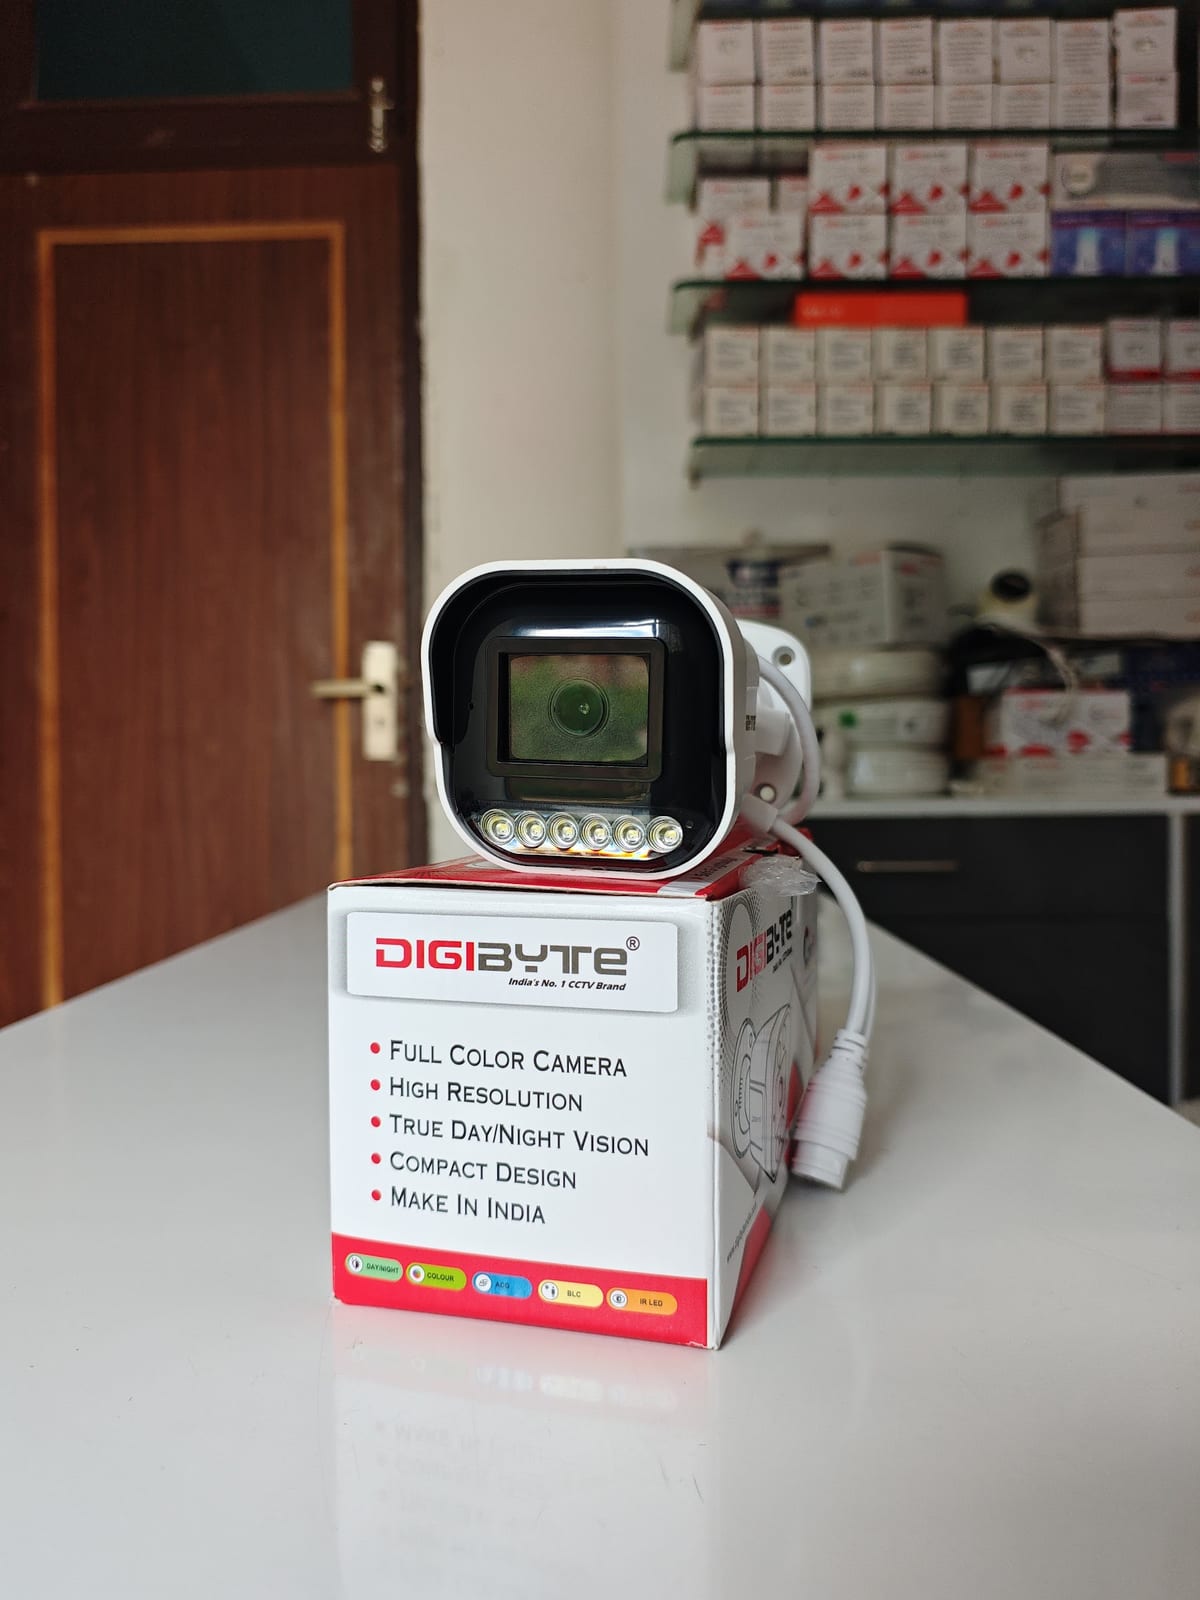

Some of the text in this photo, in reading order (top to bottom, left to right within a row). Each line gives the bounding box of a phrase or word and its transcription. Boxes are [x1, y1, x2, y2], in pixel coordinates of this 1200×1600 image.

[508, 977, 627, 991] India's No. 1 CCTV Brand
[390, 1040, 628, 1077] FULL COLOR CAMERA
[389, 1077, 583, 1112] HIGH RESOLUTION
[389, 1113, 649, 1157] TRUE DAY/NIGHT VISION
[389, 1151, 577, 1190] COMPACT DESIGN
[391, 1186, 546, 1224] MAKE IN INDIA
[427, 1271, 455, 1282] COLOUR
[567, 1289, 581, 1298] BLC
[640, 1298, 664, 1308] IR LED
